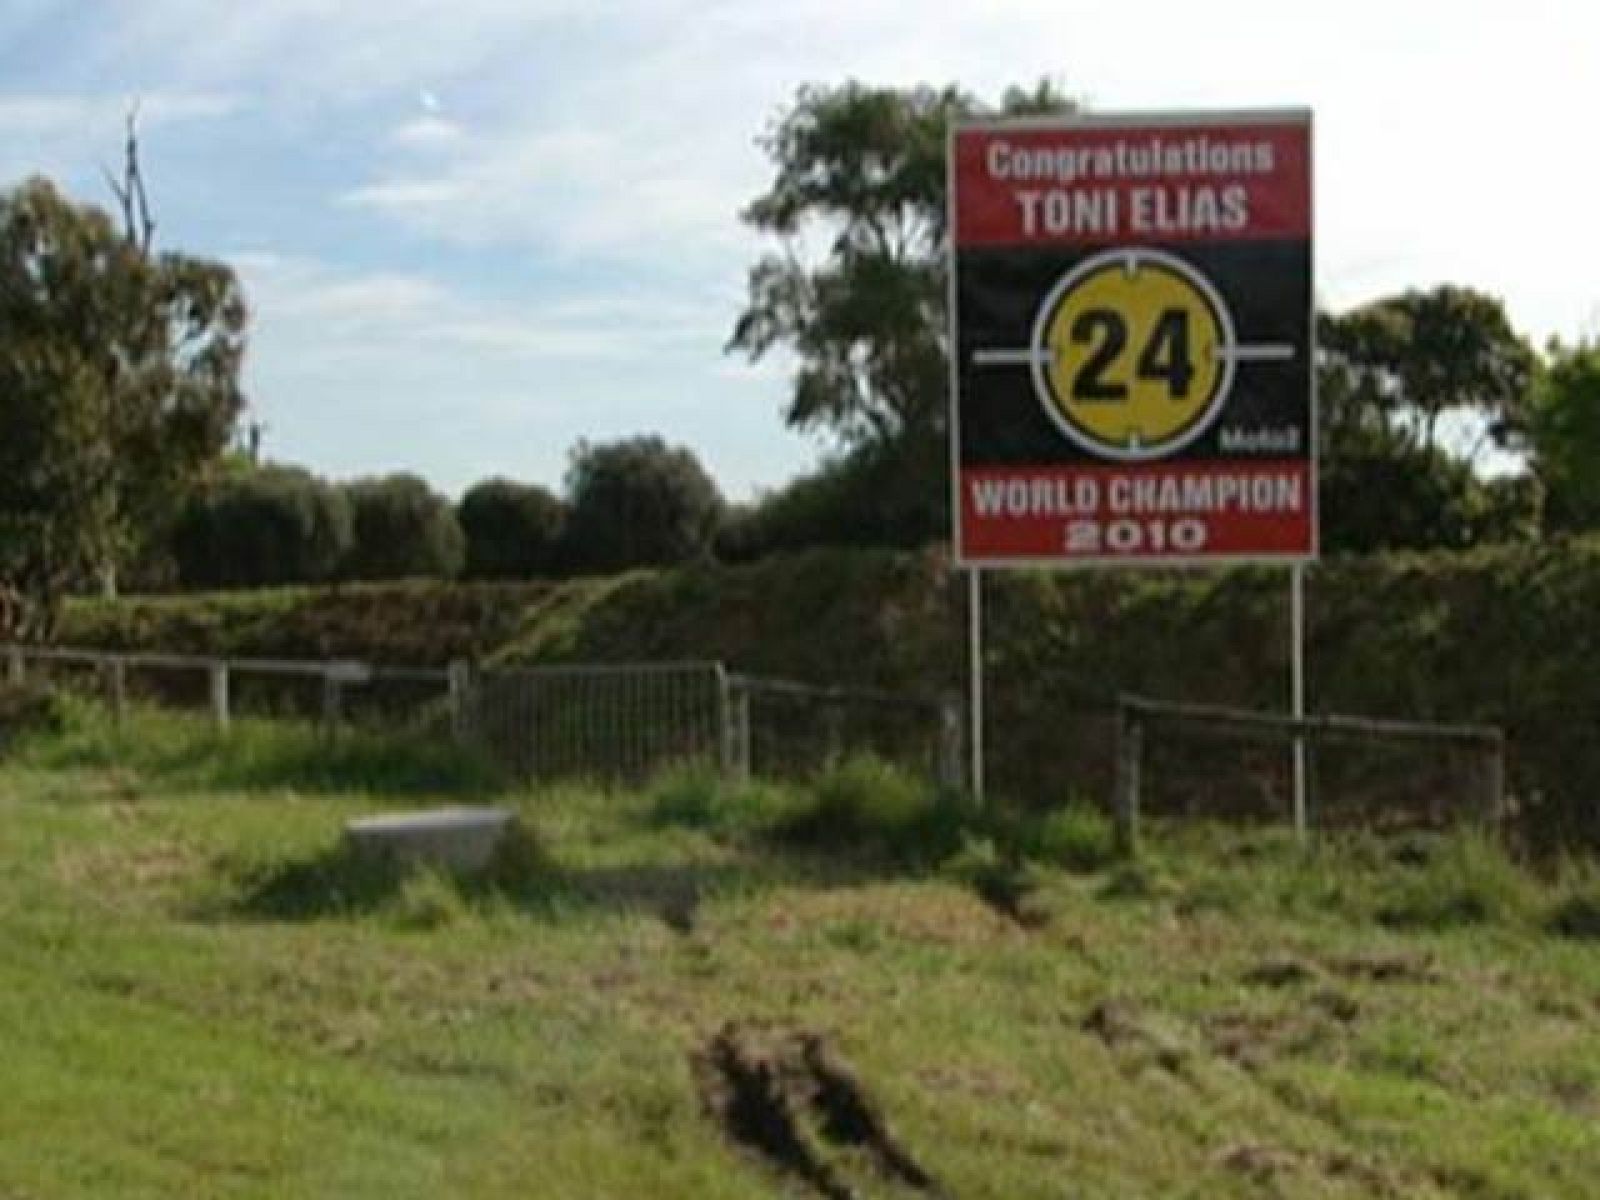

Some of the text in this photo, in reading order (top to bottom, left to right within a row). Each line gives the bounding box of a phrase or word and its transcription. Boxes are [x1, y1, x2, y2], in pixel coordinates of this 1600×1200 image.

[987, 136, 1274, 184] Congratulations
[1015, 184, 1249, 236] TONI ELIAS
[1069, 308, 1194, 400] 24
[971, 473, 1300, 517] WORLD CHAMPION
[1064, 520, 1208, 552] 2010
